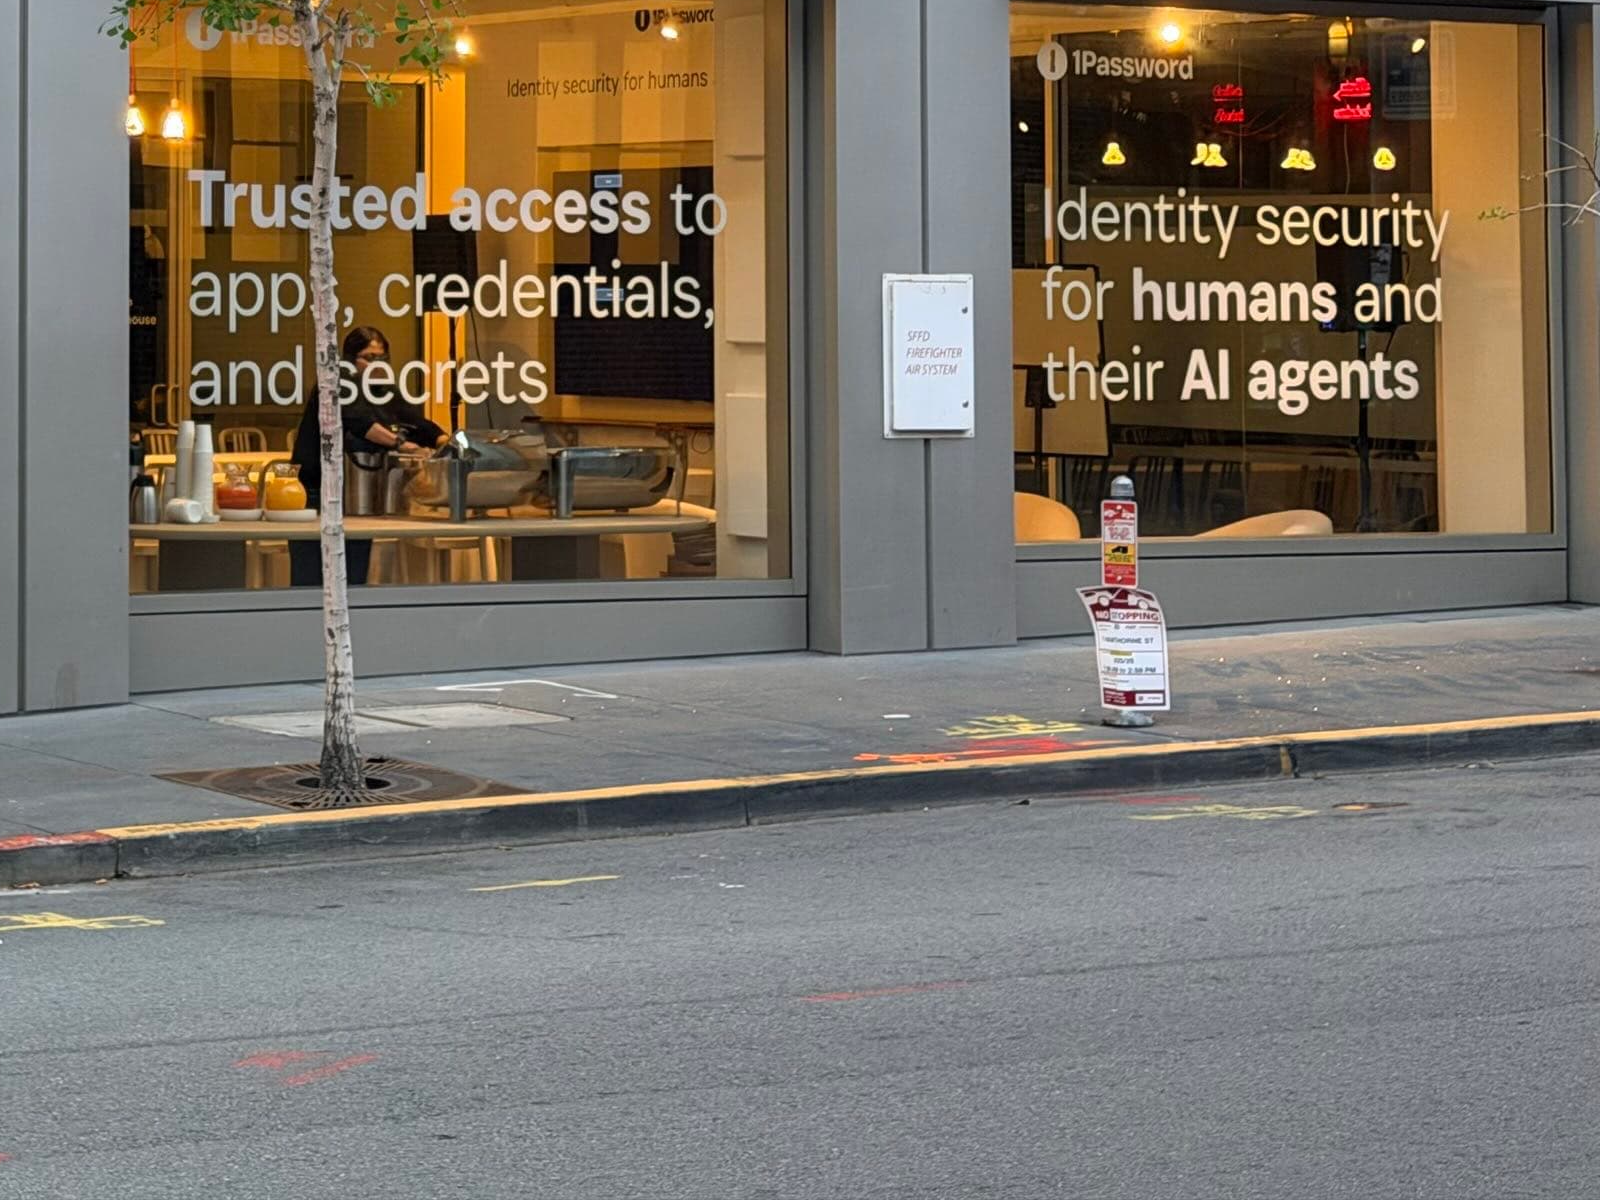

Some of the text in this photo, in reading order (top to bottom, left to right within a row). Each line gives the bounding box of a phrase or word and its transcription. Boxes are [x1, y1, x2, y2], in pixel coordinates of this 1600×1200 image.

[507, 71, 708, 99] Identity security for humans
[1072, 49, 1194, 80] 1Password
[188, 169, 727, 236] Trusted access to
[1043, 187, 1450, 262] Identity security
[378, 260, 715, 329] credentials,
[1042, 266, 1444, 323] for humans and
[905, 347, 963, 359] FIREFIGHTER
[907, 331, 931, 342] SFFD
[188, 344, 549, 406] and secrets
[905, 364, 958, 375] AIR SYSTEM
[1042, 346, 1419, 416] their AI agents
